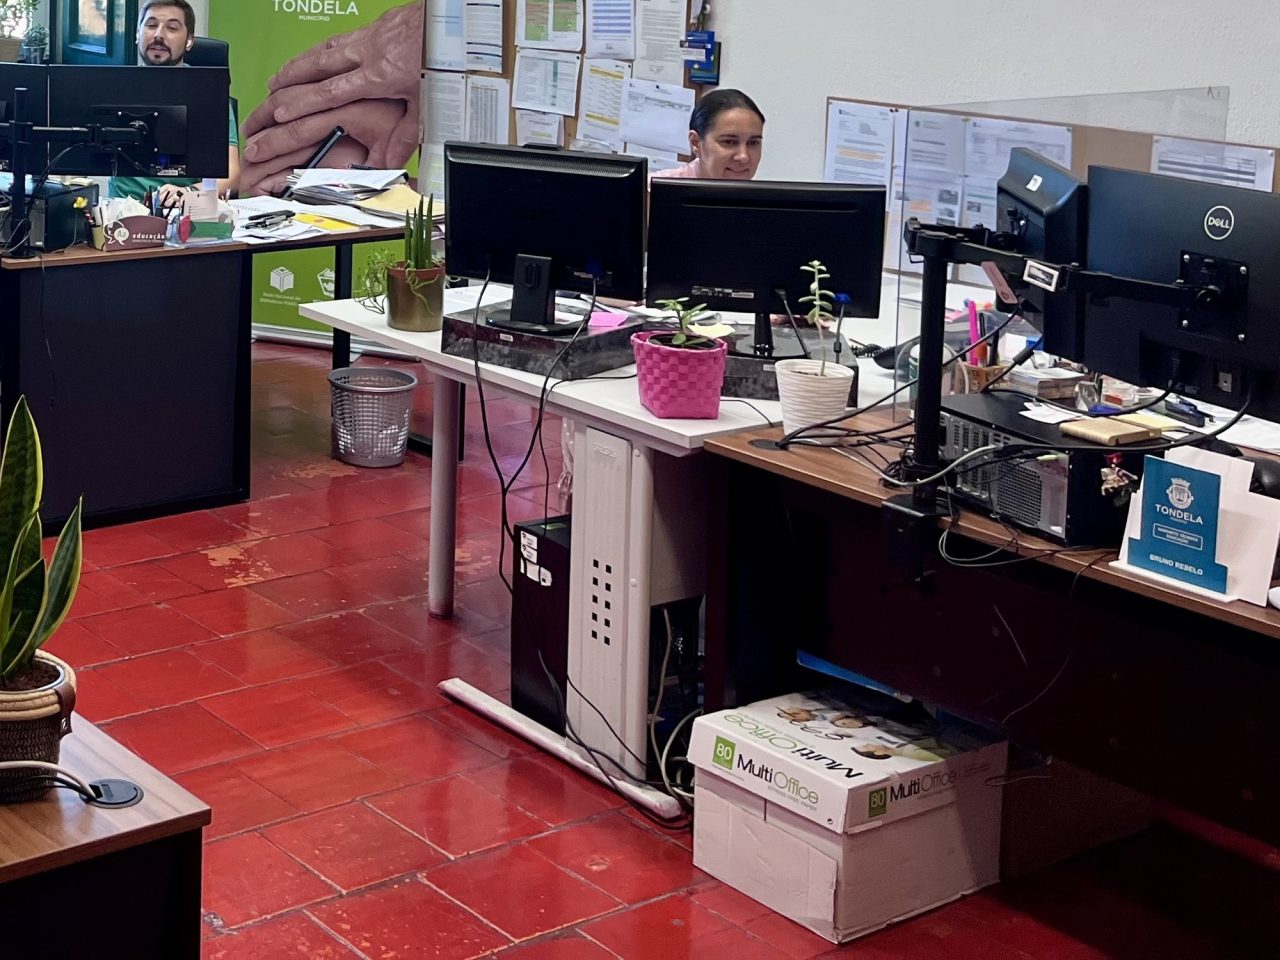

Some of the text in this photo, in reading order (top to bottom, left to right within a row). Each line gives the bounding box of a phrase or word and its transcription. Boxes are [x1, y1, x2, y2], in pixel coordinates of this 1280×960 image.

[1208, 216, 1230, 229] DELL
[1155, 503, 1204, 525] TONDELA
[1149, 554, 1204, 576] BRUNO REBELO
[716, 743, 732, 760] 80
[870, 790, 885, 808] 80
